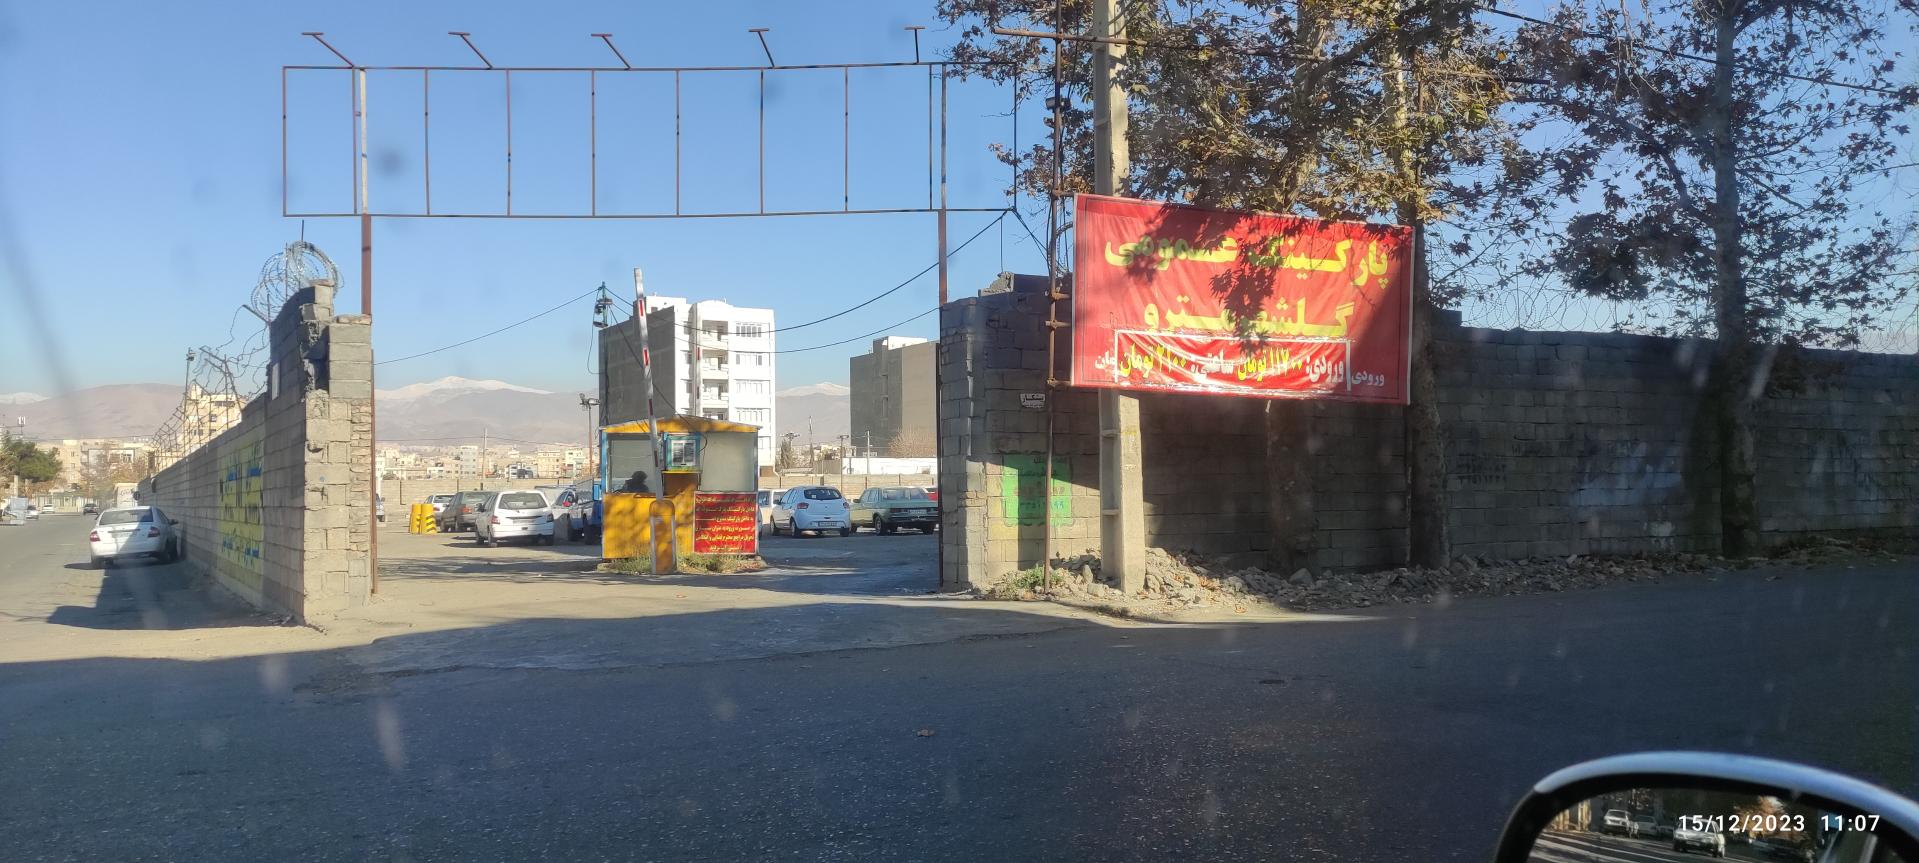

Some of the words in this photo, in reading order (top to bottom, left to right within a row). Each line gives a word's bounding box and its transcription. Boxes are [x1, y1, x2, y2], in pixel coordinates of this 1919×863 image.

[1104, 235, 1238, 271] عمومی
[1119, 342, 1154, 378] تومان
[1351, 369, 1385, 386] ورودی
